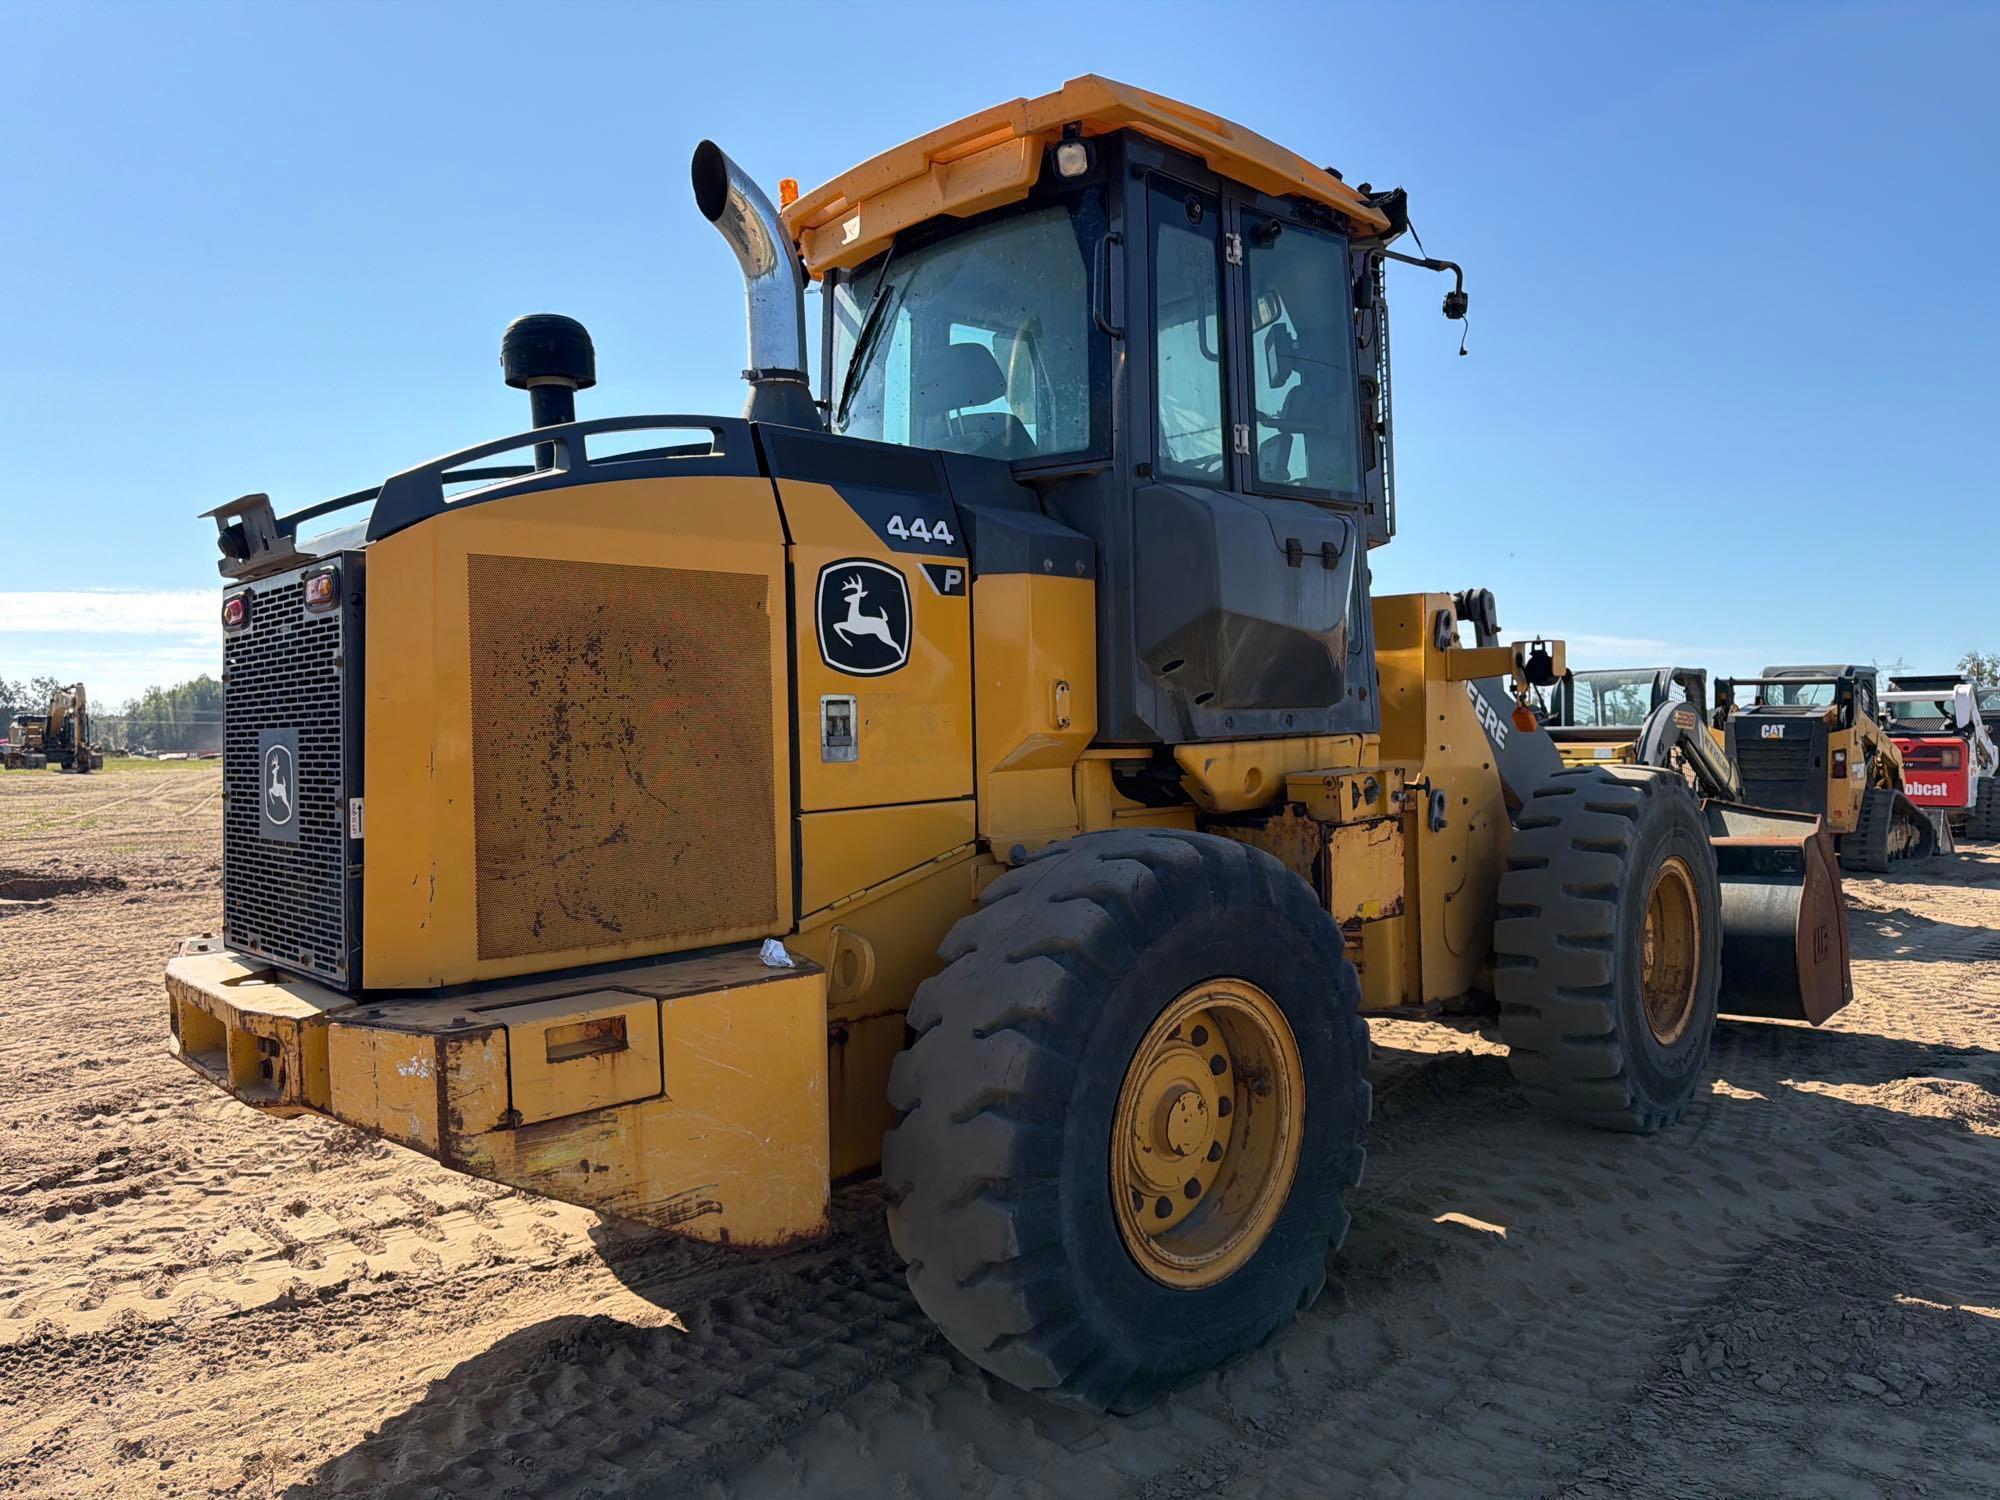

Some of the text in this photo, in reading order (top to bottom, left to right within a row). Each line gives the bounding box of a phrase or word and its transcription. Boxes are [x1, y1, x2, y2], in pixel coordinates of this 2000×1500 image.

[886, 515, 955, 545] 444
[944, 570, 962, 592] P
[1465, 680, 1509, 750] EERE
[1761, 724, 1785, 739] CAT
[1904, 781, 1948, 797] obcat
